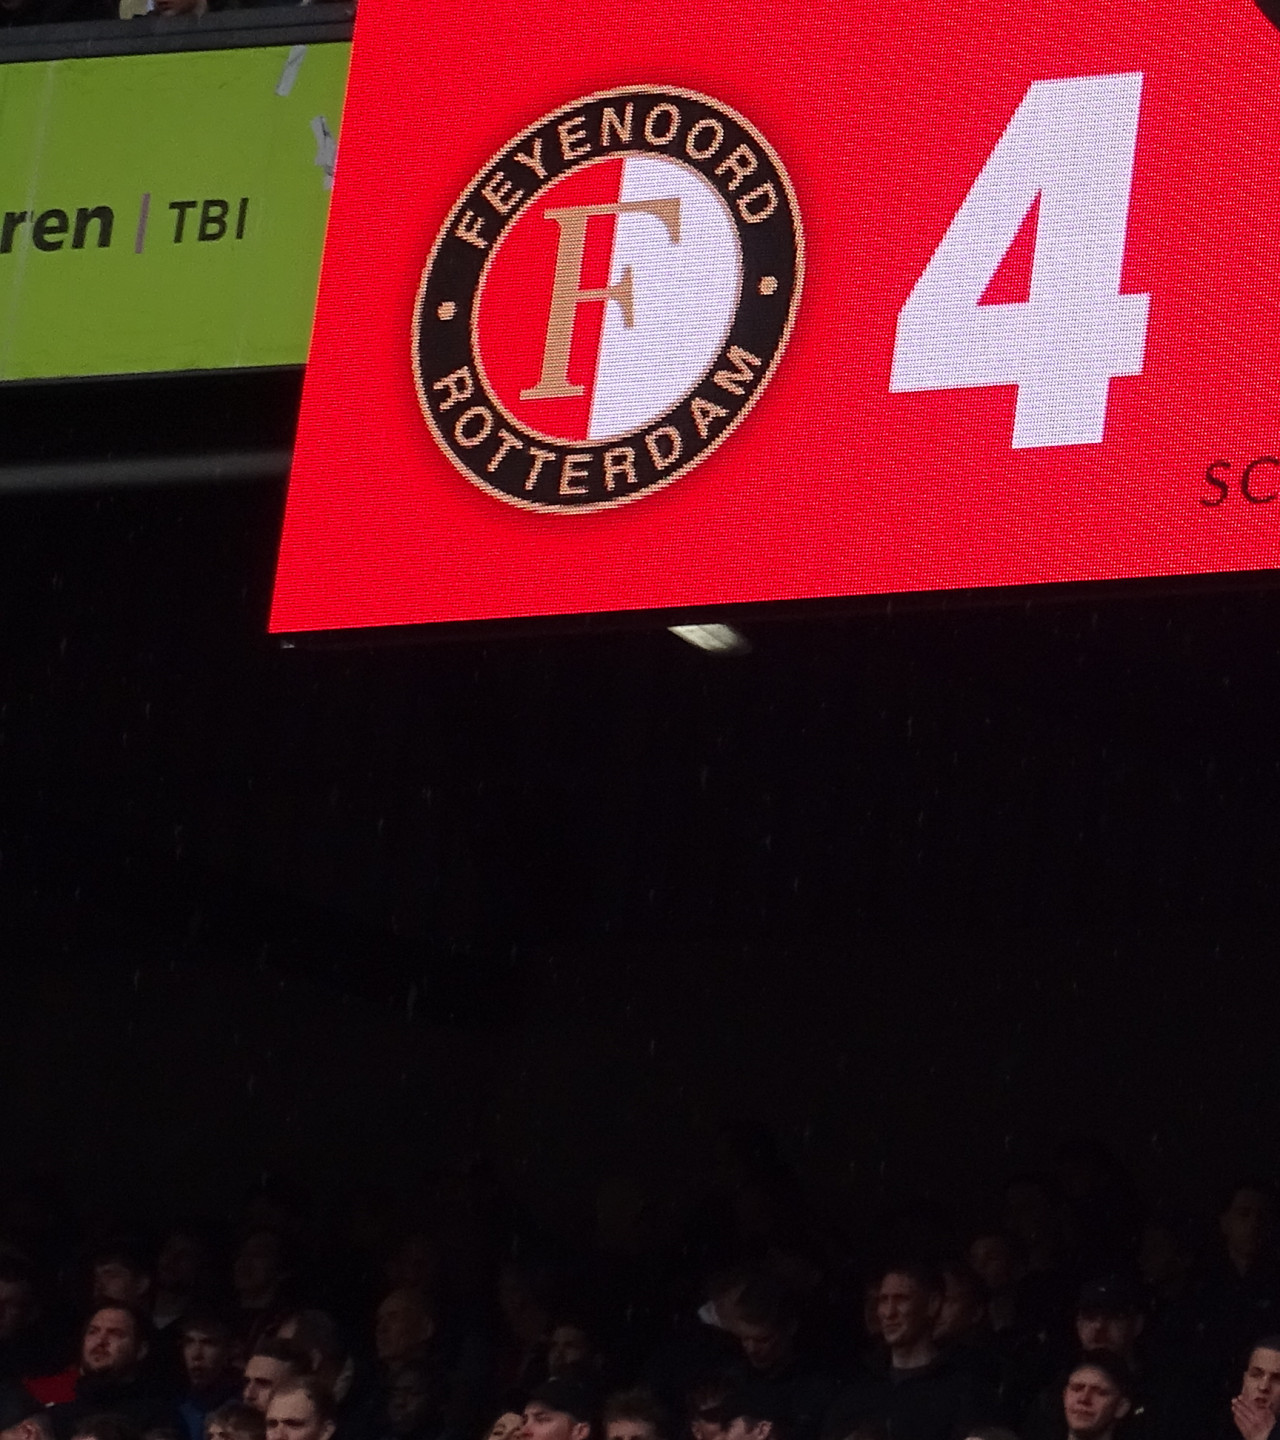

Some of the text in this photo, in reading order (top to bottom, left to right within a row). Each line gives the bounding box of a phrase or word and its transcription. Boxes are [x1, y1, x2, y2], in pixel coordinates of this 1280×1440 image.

[169, 197, 249, 244] TBI
[455, 103, 780, 249] FEYENOORD
[519, 197, 682, 400] F
[889, 70, 1151, 450] 4
[433, 344, 762, 496] ROTTERDAM
